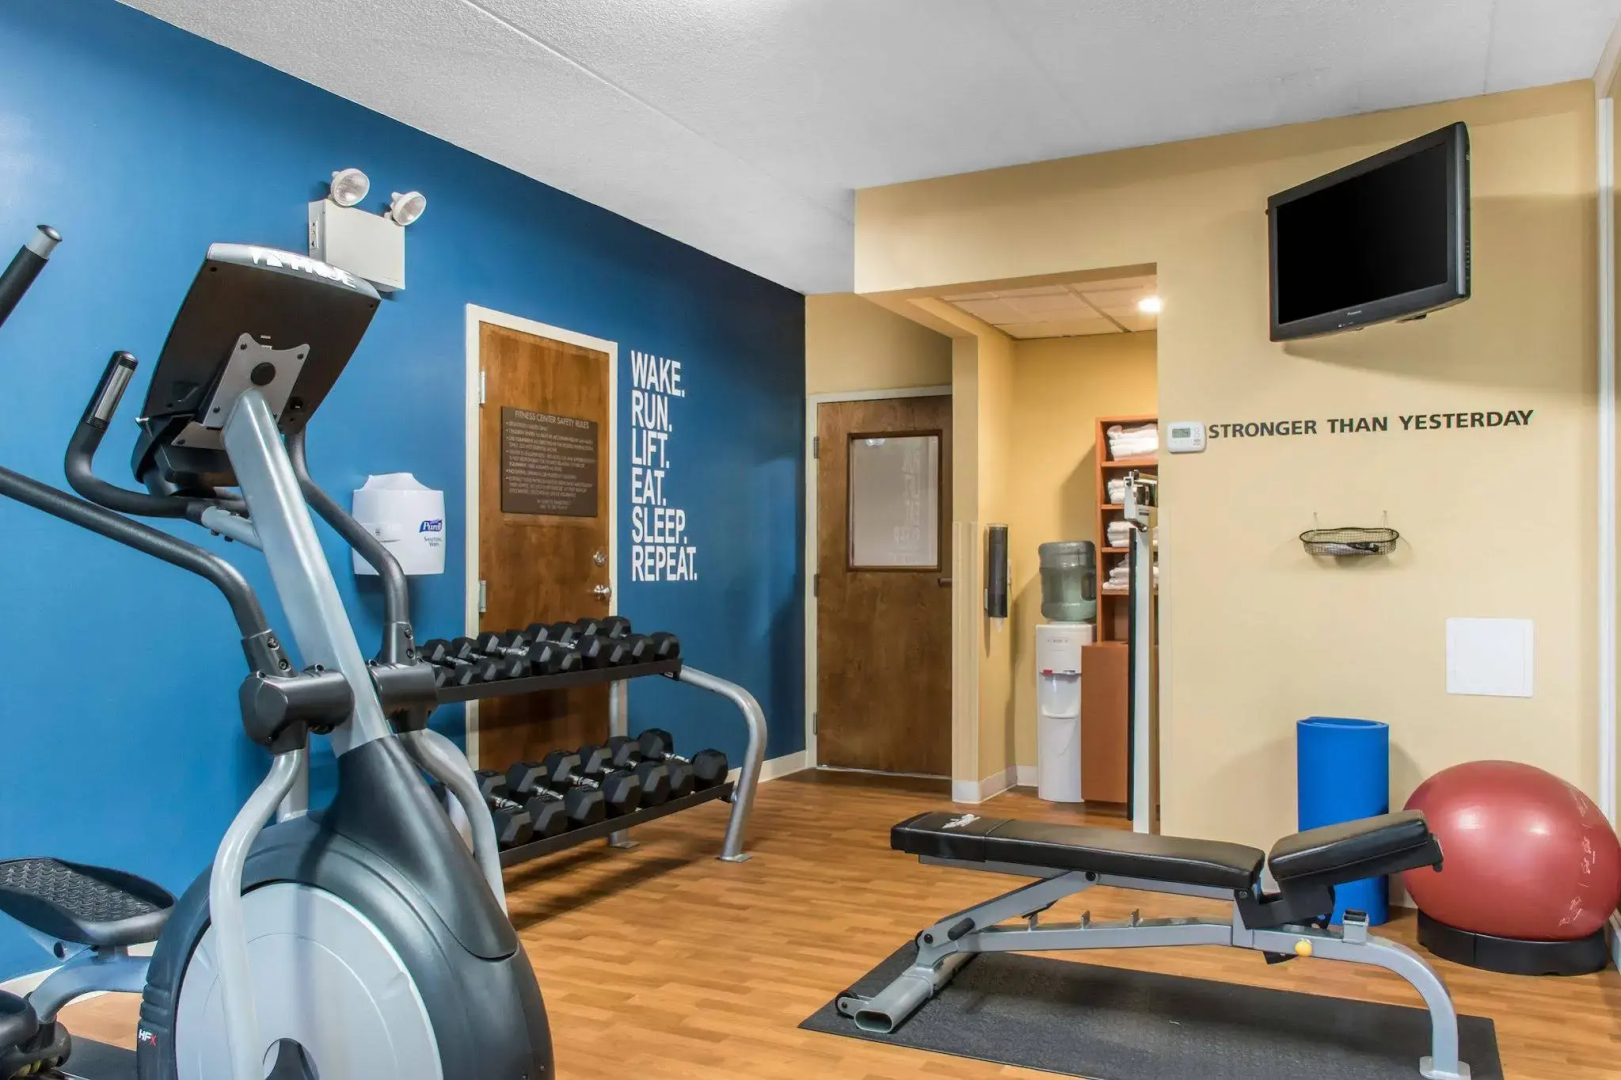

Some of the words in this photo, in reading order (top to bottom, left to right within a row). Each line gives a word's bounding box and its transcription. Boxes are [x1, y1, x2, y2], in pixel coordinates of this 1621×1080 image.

[631, 350, 685, 398] WAKE.
[514, 410, 536, 421] FITNESS
[537, 413, 557, 424] CENTER
[557, 416, 574, 427] SAFETY
[575, 420, 590, 430] RULES
[632, 389, 673, 432] RUN.
[1208, 420, 1317, 439] STRONGER
[1327, 416, 1388, 434] THAN
[1398, 410, 1534, 431] YESTERDAY
[632, 427, 670, 468] LIFT.
[632, 467, 667, 506] EAT.
[632, 505, 688, 544] SLEEP.
[632, 545, 698, 581] REPEAT.
